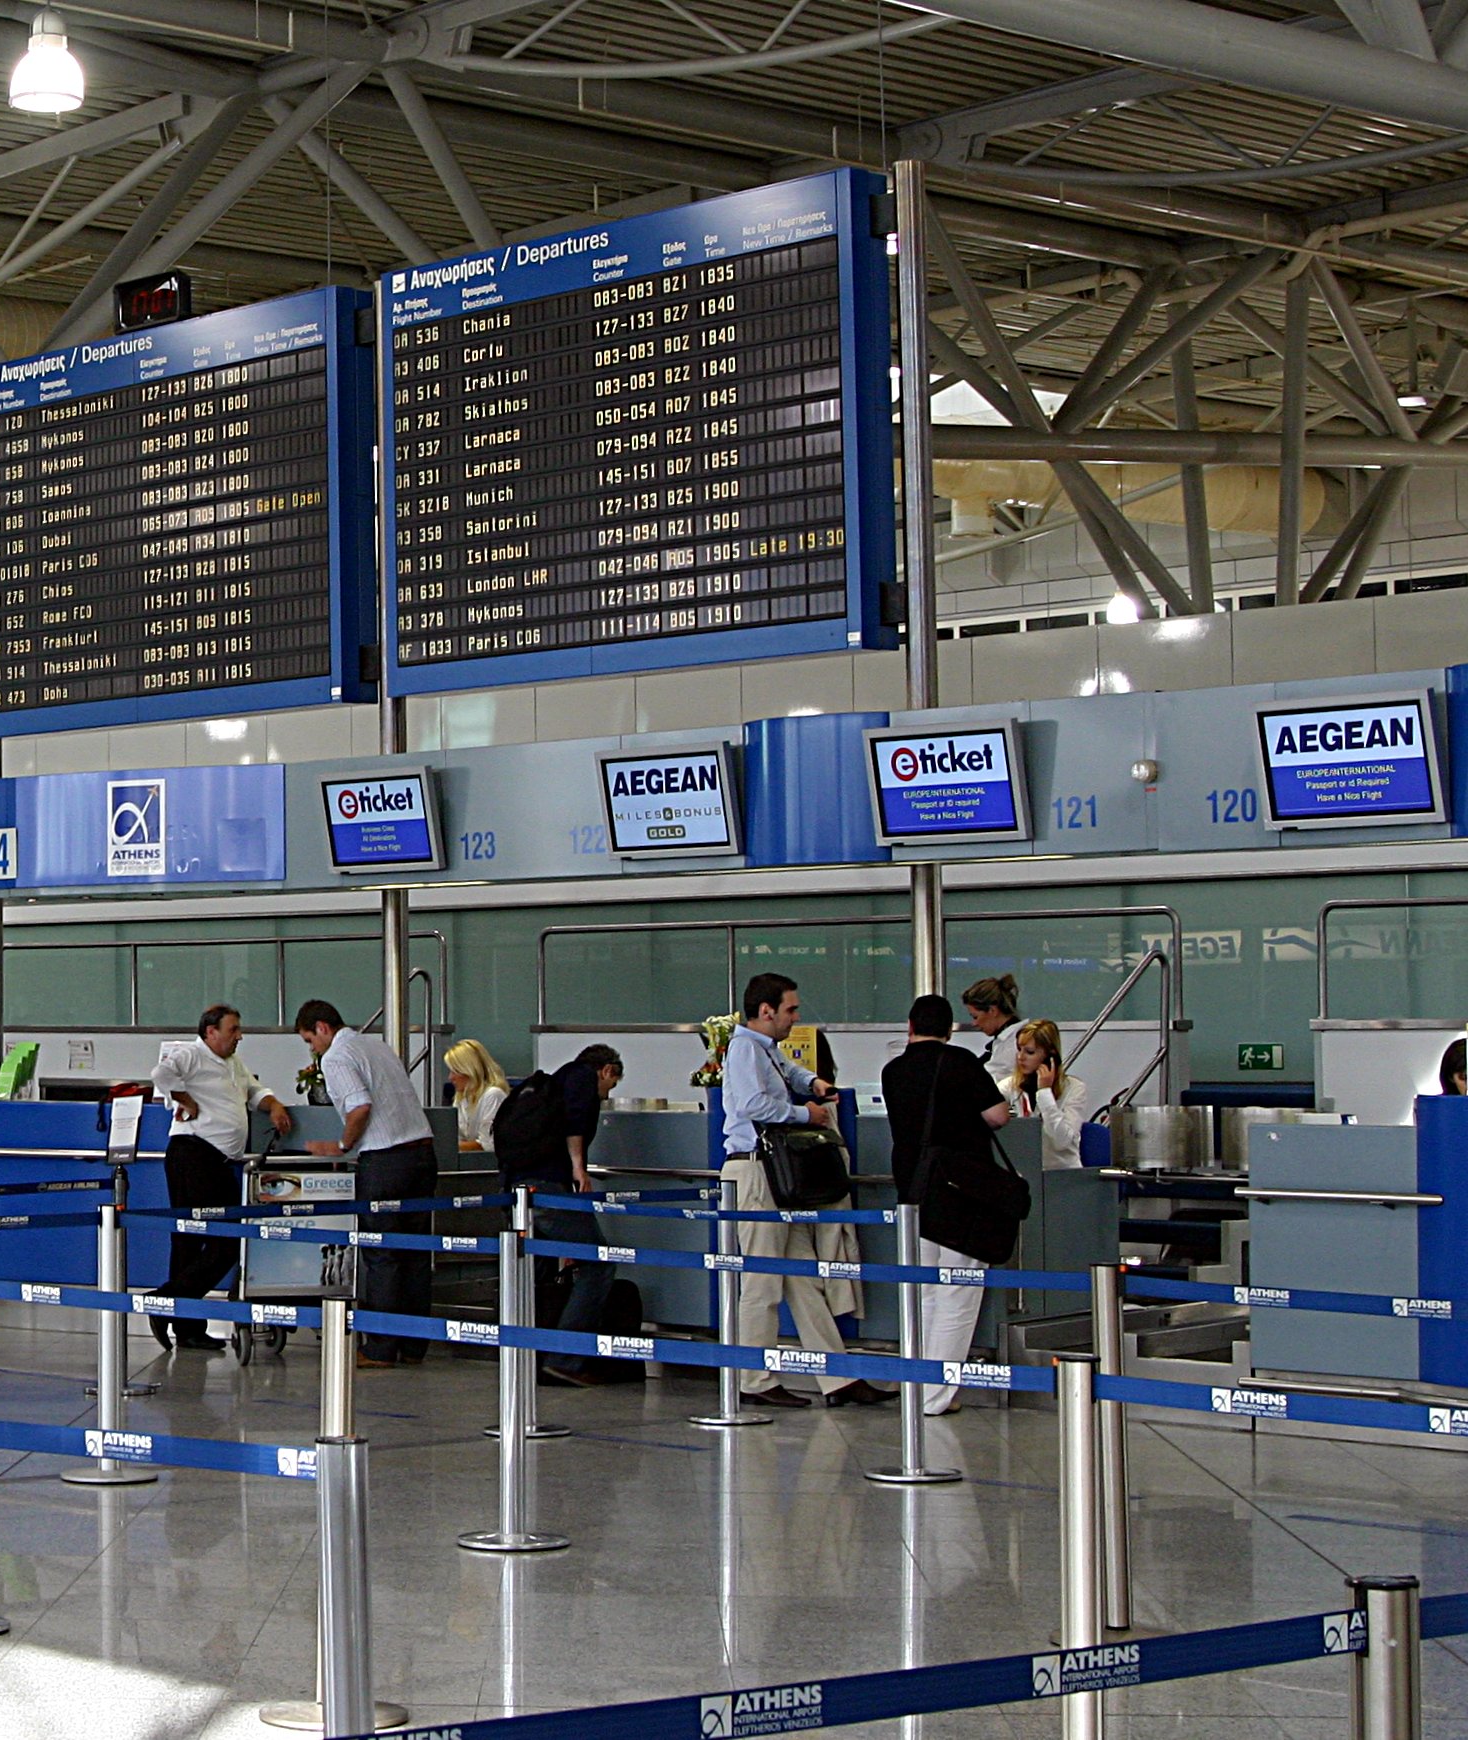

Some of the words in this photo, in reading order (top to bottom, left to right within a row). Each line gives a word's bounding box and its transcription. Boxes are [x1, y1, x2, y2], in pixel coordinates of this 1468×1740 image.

[410, 257, 495, 290] Αναχωρήσεις
[517, 232, 609, 266] Departures
[593, 267, 625, 282] Counter
[415, 326, 439, 345] 536
[462, 311, 510, 335] Chania
[593, 281, 653, 308] 083-083
[698, 264, 734, 286] 1835
[416, 354, 439, 373] 406
[462, 342, 502, 364] Corfu
[594, 311, 654, 338] 127-133
[699, 295, 735, 317] 1840
[82, 336, 152, 364] Departures
[416, 383, 440, 401] 514
[463, 366, 527, 393] Iraklion
[594, 341, 655, 368] 083-083
[700, 325, 736, 347] 1840
[417, 411, 440, 430] 782
[463, 395, 528, 421] Skiathos
[595, 371, 655, 397] 083-083
[700, 356, 737, 378] 1840
[417, 440, 441, 458] 337
[464, 426, 520, 450] Larnaca
[595, 402, 656, 427] 050-054
[701, 387, 737, 409] 1845
[418, 468, 441, 486] 331
[464, 455, 521, 479] Larnaca
[596, 432, 657, 457] 079-094
[702, 418, 738, 439] 1845
[465, 485, 513, 507] Munich
[597, 462, 658, 487] 145-151
[703, 449, 739, 470] 1855
[465, 511, 538, 536] Santorini
[597, 493, 658, 517] 127-133
[703, 480, 740, 501] 1900
[419, 554, 443, 571] 319
[466, 541, 531, 565] Istanbul
[598, 523, 659, 547] 079-094
[704, 511, 741, 532] 1900
[420, 583, 443, 600] 633
[466, 573, 515, 594] London
[523, 569, 548, 586] LHR
[599, 553, 660, 577] 042-046
[705, 542, 741, 563] 1905
[749, 535, 788, 557] Late
[796, 528, 844, 550] 19:30
[467, 601, 524, 625] Mykonos
[599, 584, 660, 607] 127-133
[706, 574, 742, 594] 1910
[468, 633, 508, 652] Paris
[600, 615, 661, 637] 111-114
[706, 605, 743, 624] 1910
[1275, 716, 1414, 755] AEGEAN
[612, 765, 717, 797] AEGEAN
[1052, 796, 1097, 830] 121
[1206, 788, 1257, 824] 120
[649, 826, 684, 838] GOLD
[112, 848, 160, 860] ATHENS
[460, 831, 496, 860] 123
[303, 1176, 353, 1190] Greece
[1, 1216, 29, 1224] ATHENS
[358, 1232, 382, 1242] ATHENS
[452, 1238, 477, 1246] ATHENS
[609, 1246, 636, 1257] ATHENS
[715, 1256, 744, 1265] ATHENS
[830, 1263, 860, 1273] ATHENS
[951, 1268, 984, 1279] ATHENS
[32, 1285, 60, 1297] ATHENS
[1249, 1288, 1289, 1300] ATHENS
[143, 1296, 175, 1308] ATHENS
[263, 1304, 297, 1318] ATHENS
[1408, 1299, 1452, 1310] ATHENS
[460, 1322, 499, 1336] ATHENS
[612, 1336, 654, 1350] ATHENS
[780, 1351, 827, 1364] ATHENS
[961, 1363, 1011, 1377] ATHENS
[1232, 1390, 1287, 1406] ATHENS
[103, 1432, 152, 1450] ATHENS
[1062, 1644, 1140, 1672] ATHENS
[1062, 1667, 1111, 1684] INTERNATIONAL
[1112, 1664, 1140, 1677] AIRPORT
[734, 1684, 822, 1714] ATHENS
[734, 1710, 790, 1726] INTERNATIONAL
[792, 1706, 822, 1719] AIRPORT
